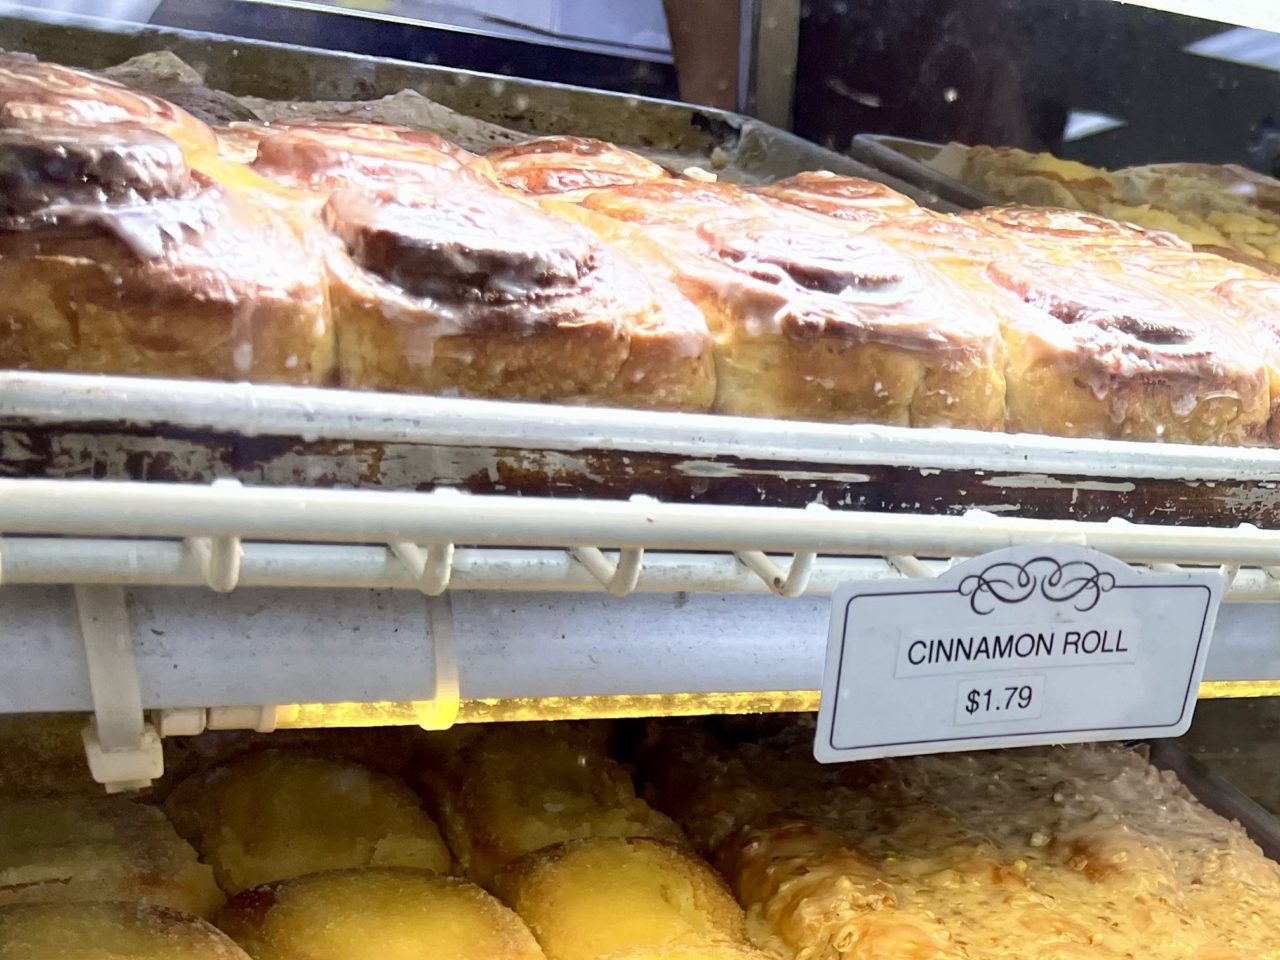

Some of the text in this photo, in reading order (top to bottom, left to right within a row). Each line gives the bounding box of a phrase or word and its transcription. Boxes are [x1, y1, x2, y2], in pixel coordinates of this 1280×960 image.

[908, 629, 1128, 665] CINNAMON ROLL
[966, 686, 1033, 715] $1.79
